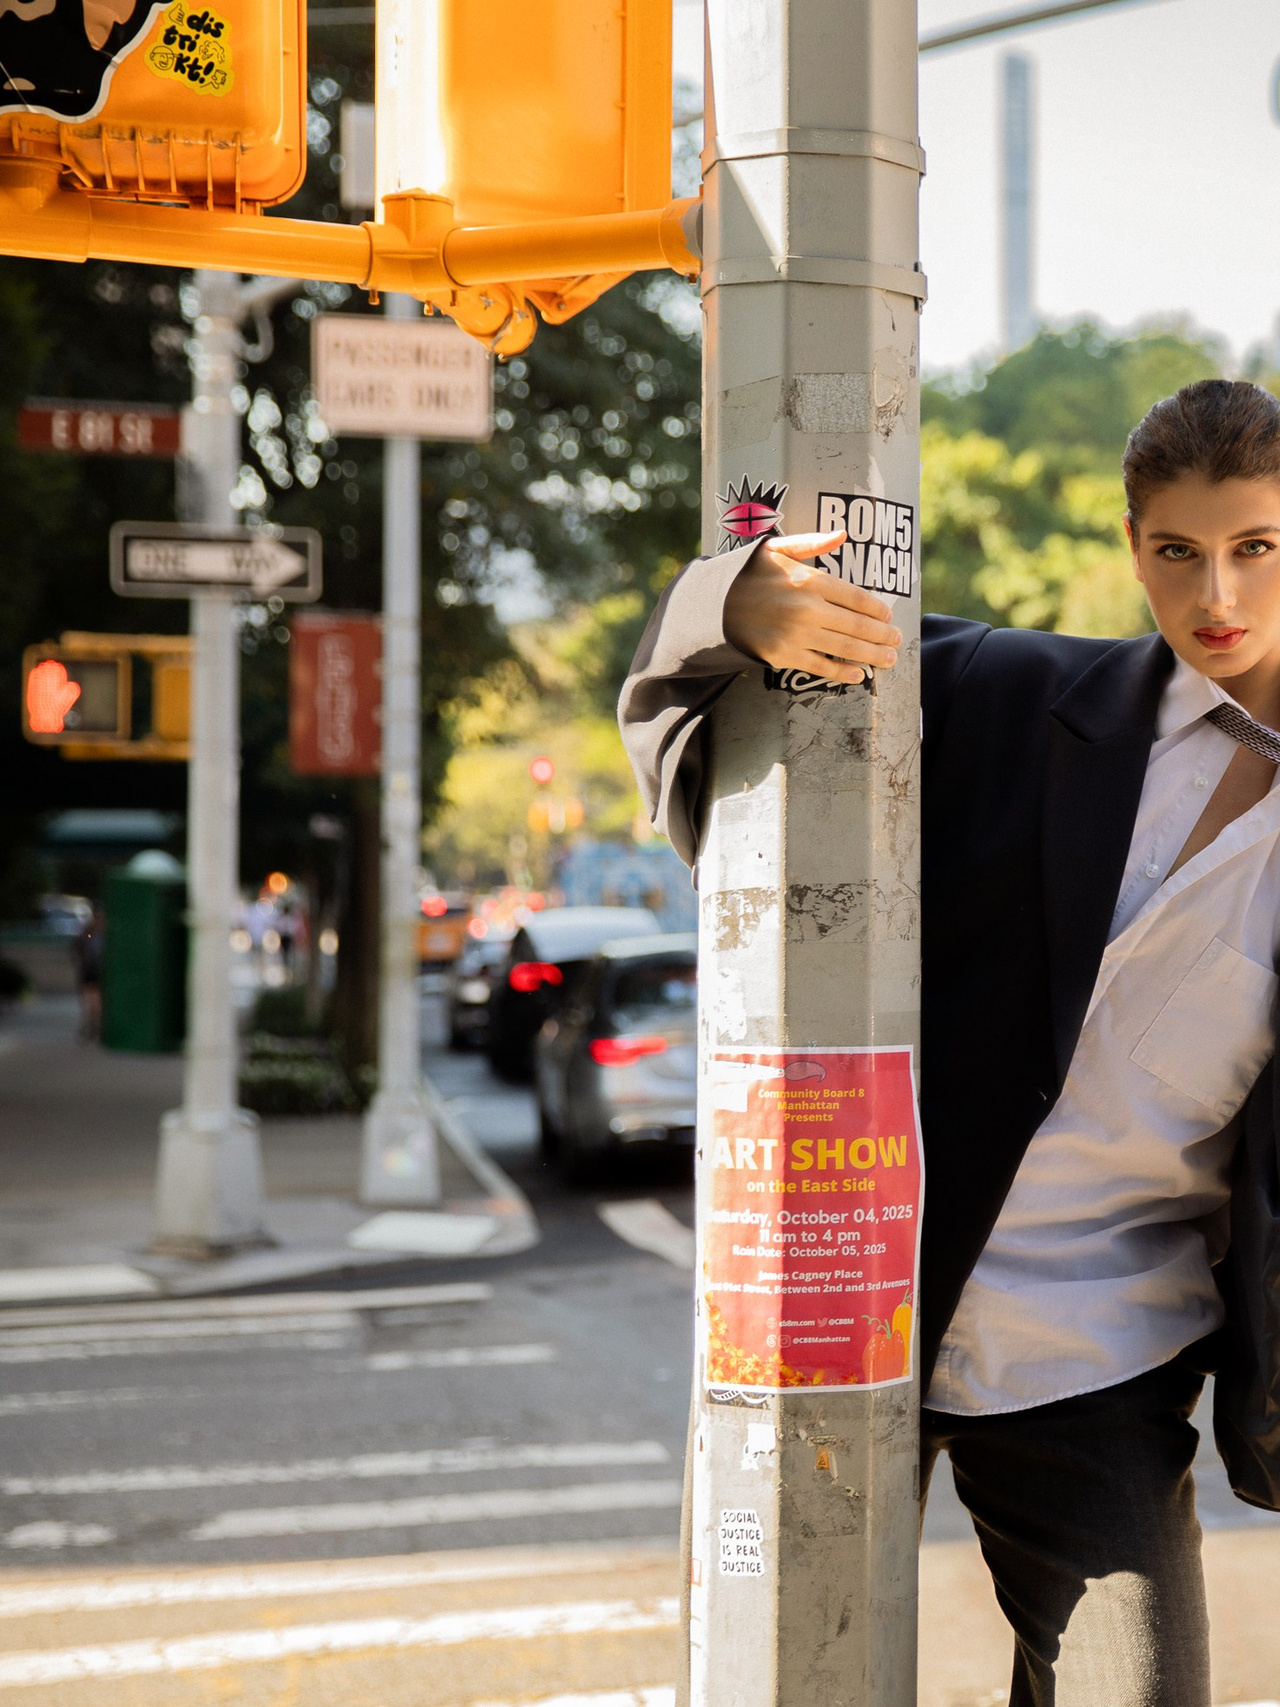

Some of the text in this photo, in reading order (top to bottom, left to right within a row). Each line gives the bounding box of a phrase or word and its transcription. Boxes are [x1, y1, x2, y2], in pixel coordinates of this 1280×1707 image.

[187, 11, 224, 38] dis
[163, 25, 200, 52] tri
[51, 411, 71, 449] E
[820, 495, 911, 551] BOM5
[819, 543, 911, 595] SNACH
[758, 1088, 865, 1101] Community Board 8
[777, 1101, 840, 1110] Manhattan
[784, 1113, 834, 1122] Presents
[711, 1135, 907, 1171] ART SHOW
[746, 1178, 876, 1194] on the East Side
[777, 1209, 849, 1225] October
[853, 1208, 879, 1224] 04,
[882, 1204, 914, 1221] 2025
[759, 1228, 861, 1245] 11 am to 4 pm
[732, 1243, 886, 1258] Rain Date: October 05, 2025
[757, 1269, 863, 1283] James Cagney Place
[774, 1284, 821, 1295] Between
[822, 1284, 843, 1293] 2nd
[845, 1283, 865, 1292] and
[866, 1281, 881, 1291] 3rd
[882, 1279, 911, 1290] Avenues
[723, 1511, 757, 1524] SOCIAL
[721, 1528, 761, 1540] JUSTICE
[722, 1544, 760, 1557] IS REAL
[722, 1561, 761, 1573] JUSTICE
